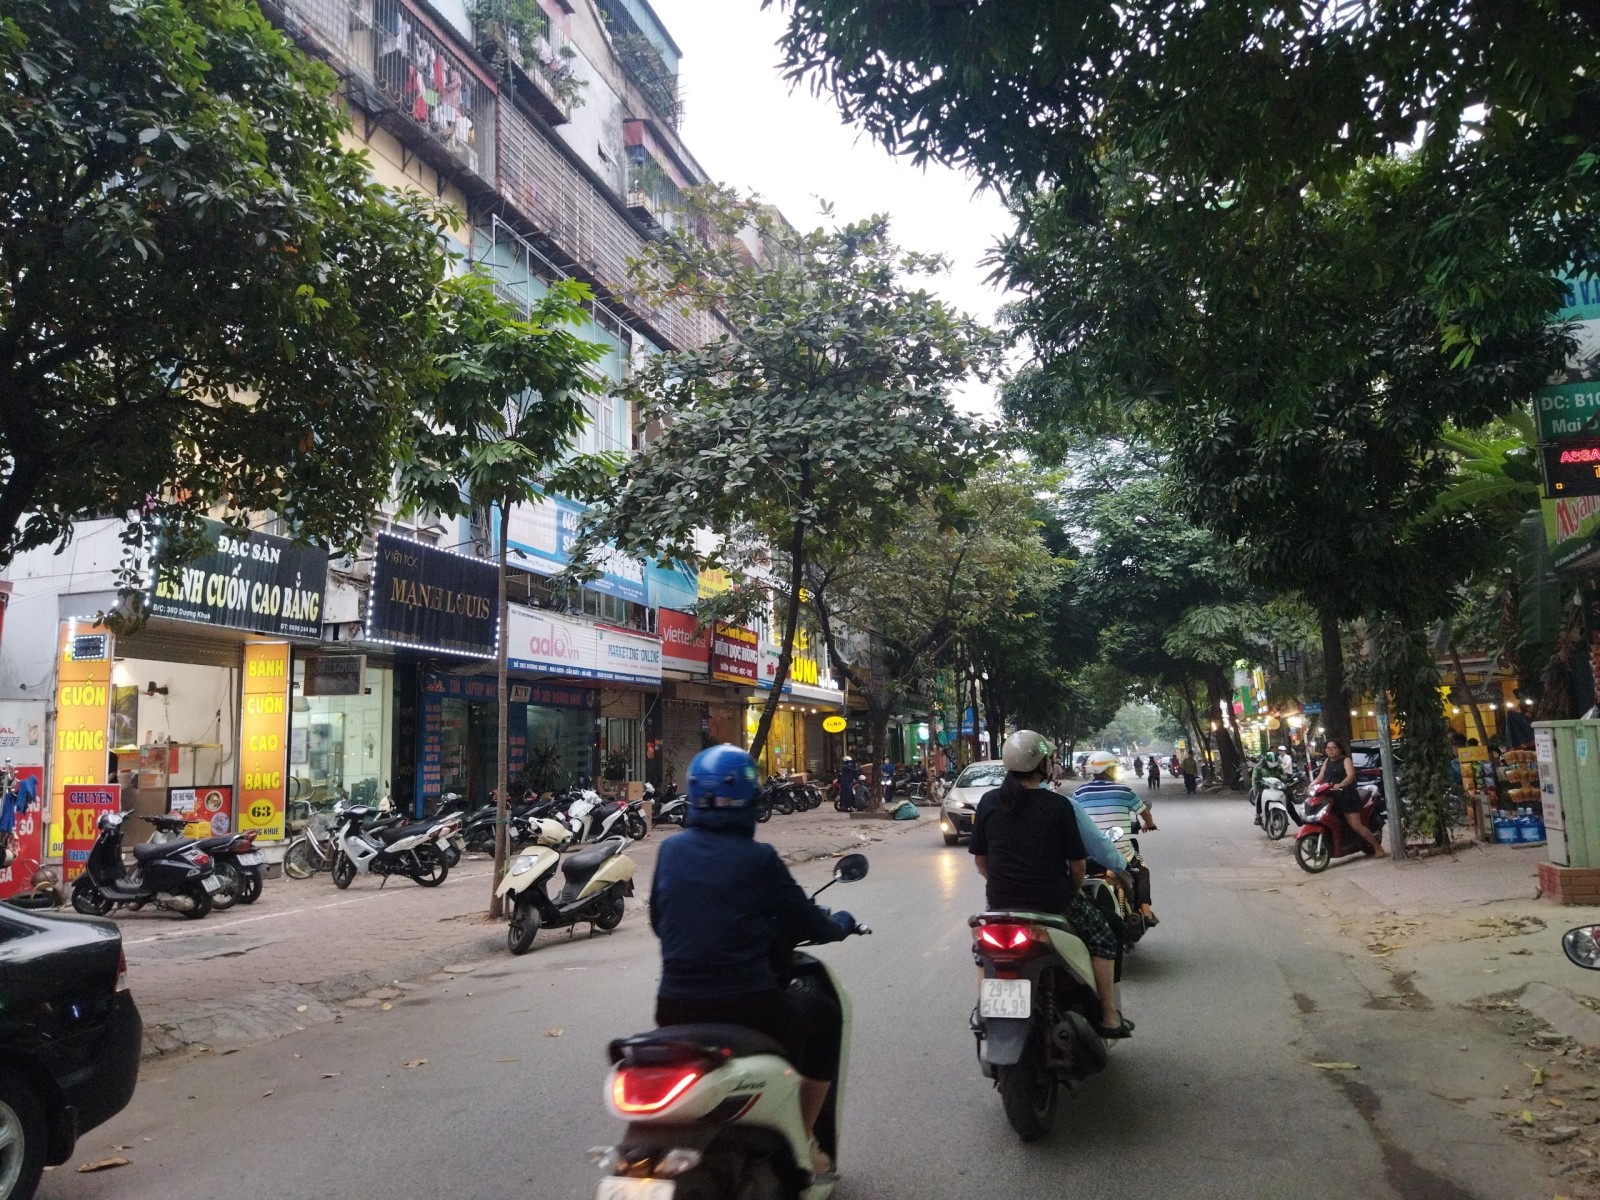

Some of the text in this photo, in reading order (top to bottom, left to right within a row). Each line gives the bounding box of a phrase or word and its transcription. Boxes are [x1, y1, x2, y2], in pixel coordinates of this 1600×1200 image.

[1552, 417, 1582, 434] Mai
[251, 540, 281, 564] SẢN
[206, 563, 250, 611] CUỐN
[251, 581, 281, 616] CAO
[281, 572, 319, 622] BẰNG
[445, 590, 490, 620] LOUIS
[249, 654, 284, 677] BÁNH
[608, 644, 659, 664] MARKETING ONLINE
[791, 656, 817, 685] LUNA
[61, 673, 106, 707] CUỐN
[246, 686, 283, 714] CUỐN
[57, 723, 104, 752] TRỨNG
[249, 734, 279, 752] CAO
[244, 762, 280, 791] BẰNG
[69, 790, 113, 805] CHUYÊN
[66, 808, 96, 840] XE
[251, 805, 271, 818] 63
[19, 815, 34, 836] SỐ
